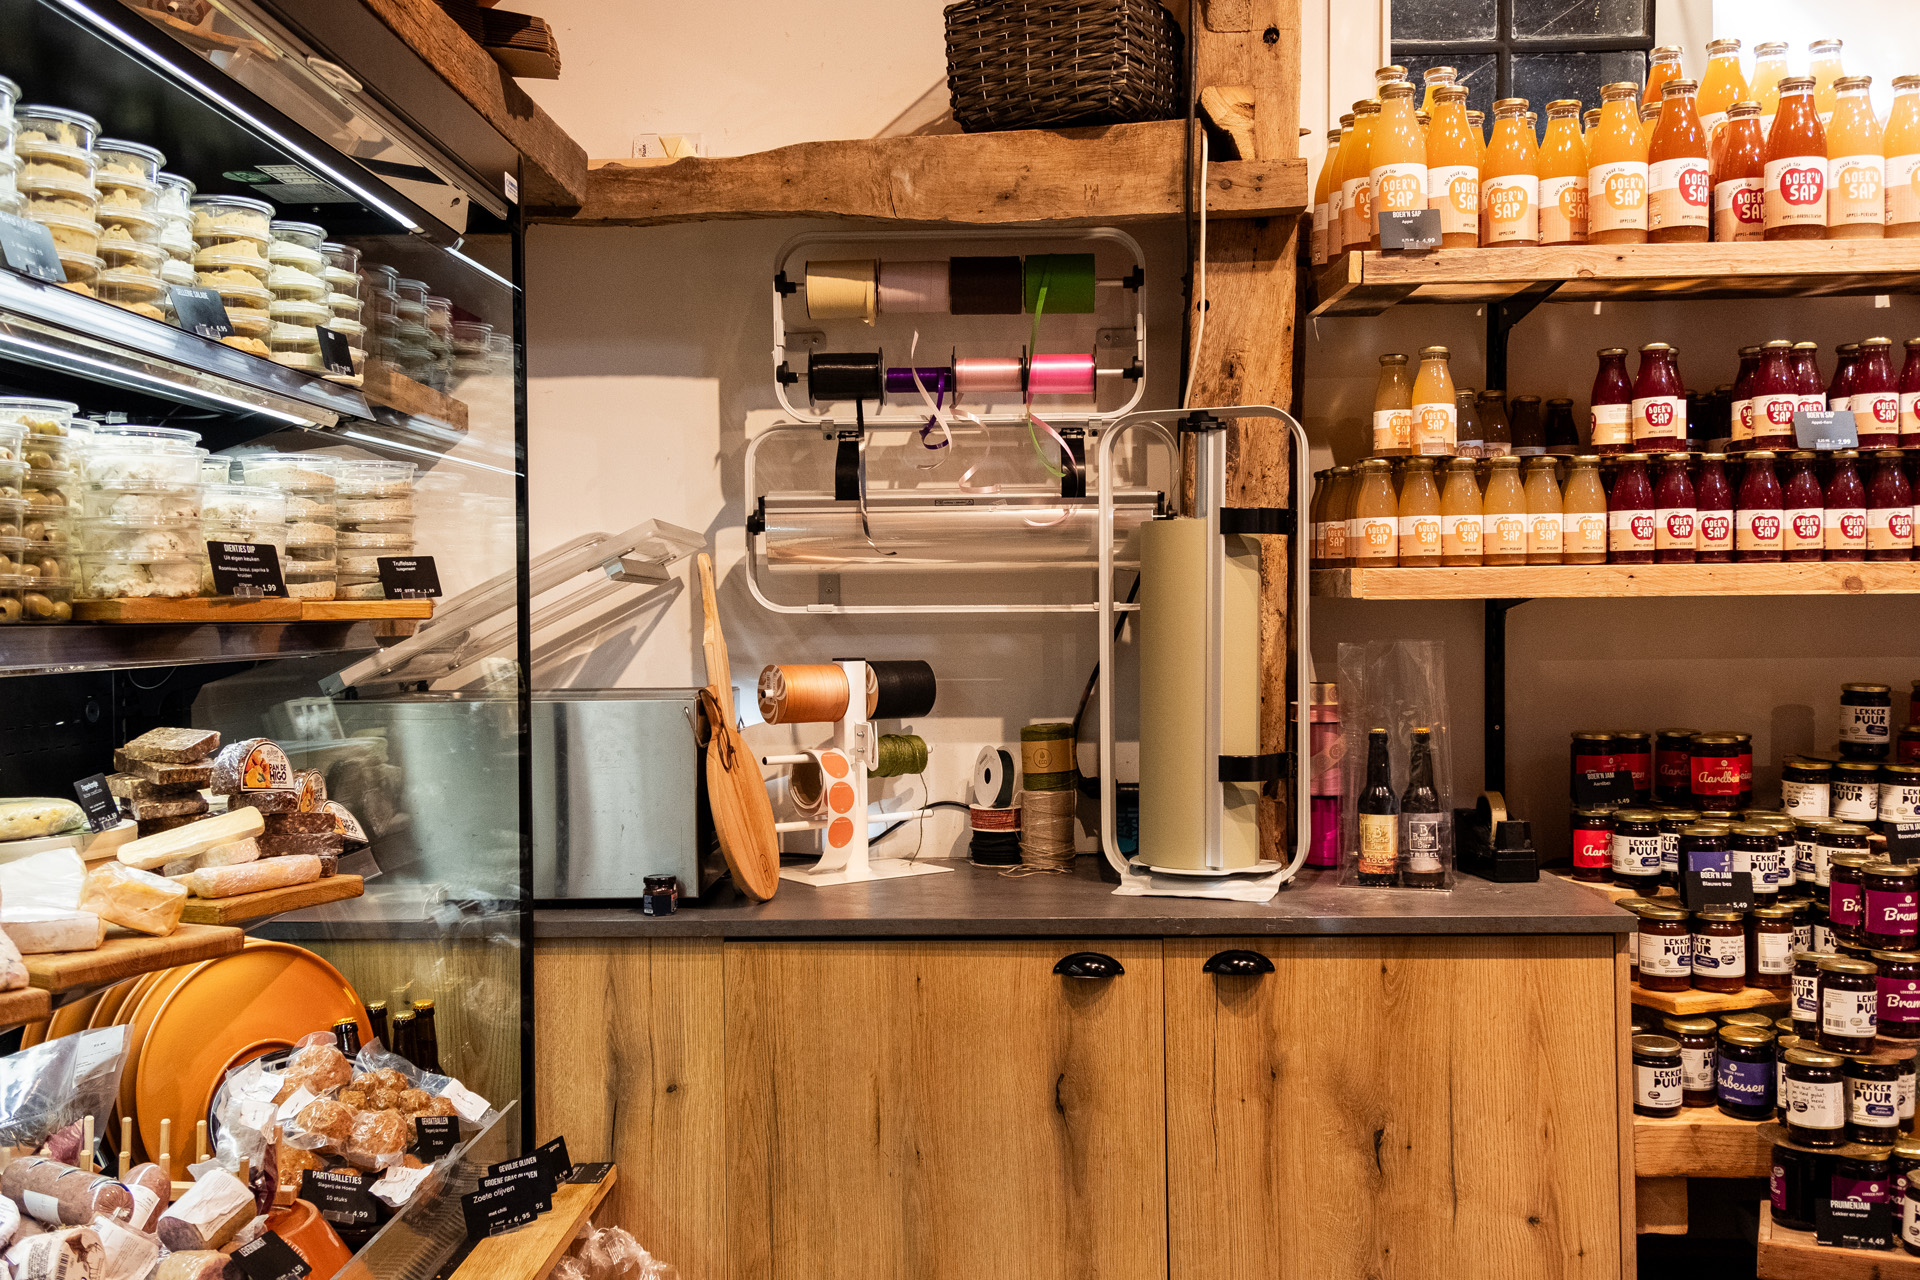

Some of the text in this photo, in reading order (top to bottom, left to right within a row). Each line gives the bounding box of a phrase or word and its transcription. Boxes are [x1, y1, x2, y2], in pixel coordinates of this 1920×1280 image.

[1785, 172, 1820, 185] BOER'N
[1844, 170, 1878, 184] BOER'N
[1383, 179, 1417, 192] BOER'N
[1610, 177, 1644, 190] BOER'N
[1790, 184, 1818, 201] SAP
[1848, 183, 1876, 199] SAP
[1387, 191, 1414, 207] SAP
[1490, 191, 1524, 204] BOER'N
[1615, 190, 1641, 205] SAP
[1494, 203, 1520, 218] SAP
[1648, 405, 1671, 414] BOER'N
[1424, 412, 1447, 420] BOER'N
[1651, 414, 1670, 424] SAP
[1772, 412, 1791, 422] SAP
[1879, 410, 1896, 420] SAP
[1427, 420, 1445, 430] SAP
[1670, 517, 1692, 525] BOER'N
[1755, 518, 1778, 526] BOER'N
[1796, 518, 1818, 526] BOER'N
[1368, 526, 1390, 534] BOER'N
[1503, 530, 1519, 540] SAP
[1540, 530, 1556, 540] SAP
[1585, 530, 1602, 540] SAP
[1637, 527, 1652, 537] SAP
[1673, 526, 1690, 536] SAP
[1708, 528, 1725, 538] SAP
[1758, 526, 1776, 537] SAP
[1800, 526, 1817, 536] SAP
[1847, 526, 1863, 536] SAP
[1895, 526, 1910, 536] SAP
[1371, 534, 1388, 544] SAP
[1421, 533, 1436, 543] SAP
[1462, 532, 1478, 542] SAP
[247, 545, 255, 553] DIP
[1855, 716, 1885, 724] PUUR
[269, 763, 279, 771] PAN
[270, 771, 287, 780] HIGO
[1420, 825, 1428, 836] B
[1629, 846, 1658, 855] PUUR
[1854, 1082, 1892, 1092] LEKKER
[1854, 1090, 1892, 1103] PUUR
[498, 1156, 537, 1173] GEVULDE OLIJVEN
[312, 1171, 362, 1185] PARTYBALLETJES
[484, 1177, 504, 1188] GROENE
[473, 1185, 515, 1204] Zoete olijven
[1830, 1200, 1870, 1210] PRUIMENJAM
[514, 1212, 530, 1223] 6,95
